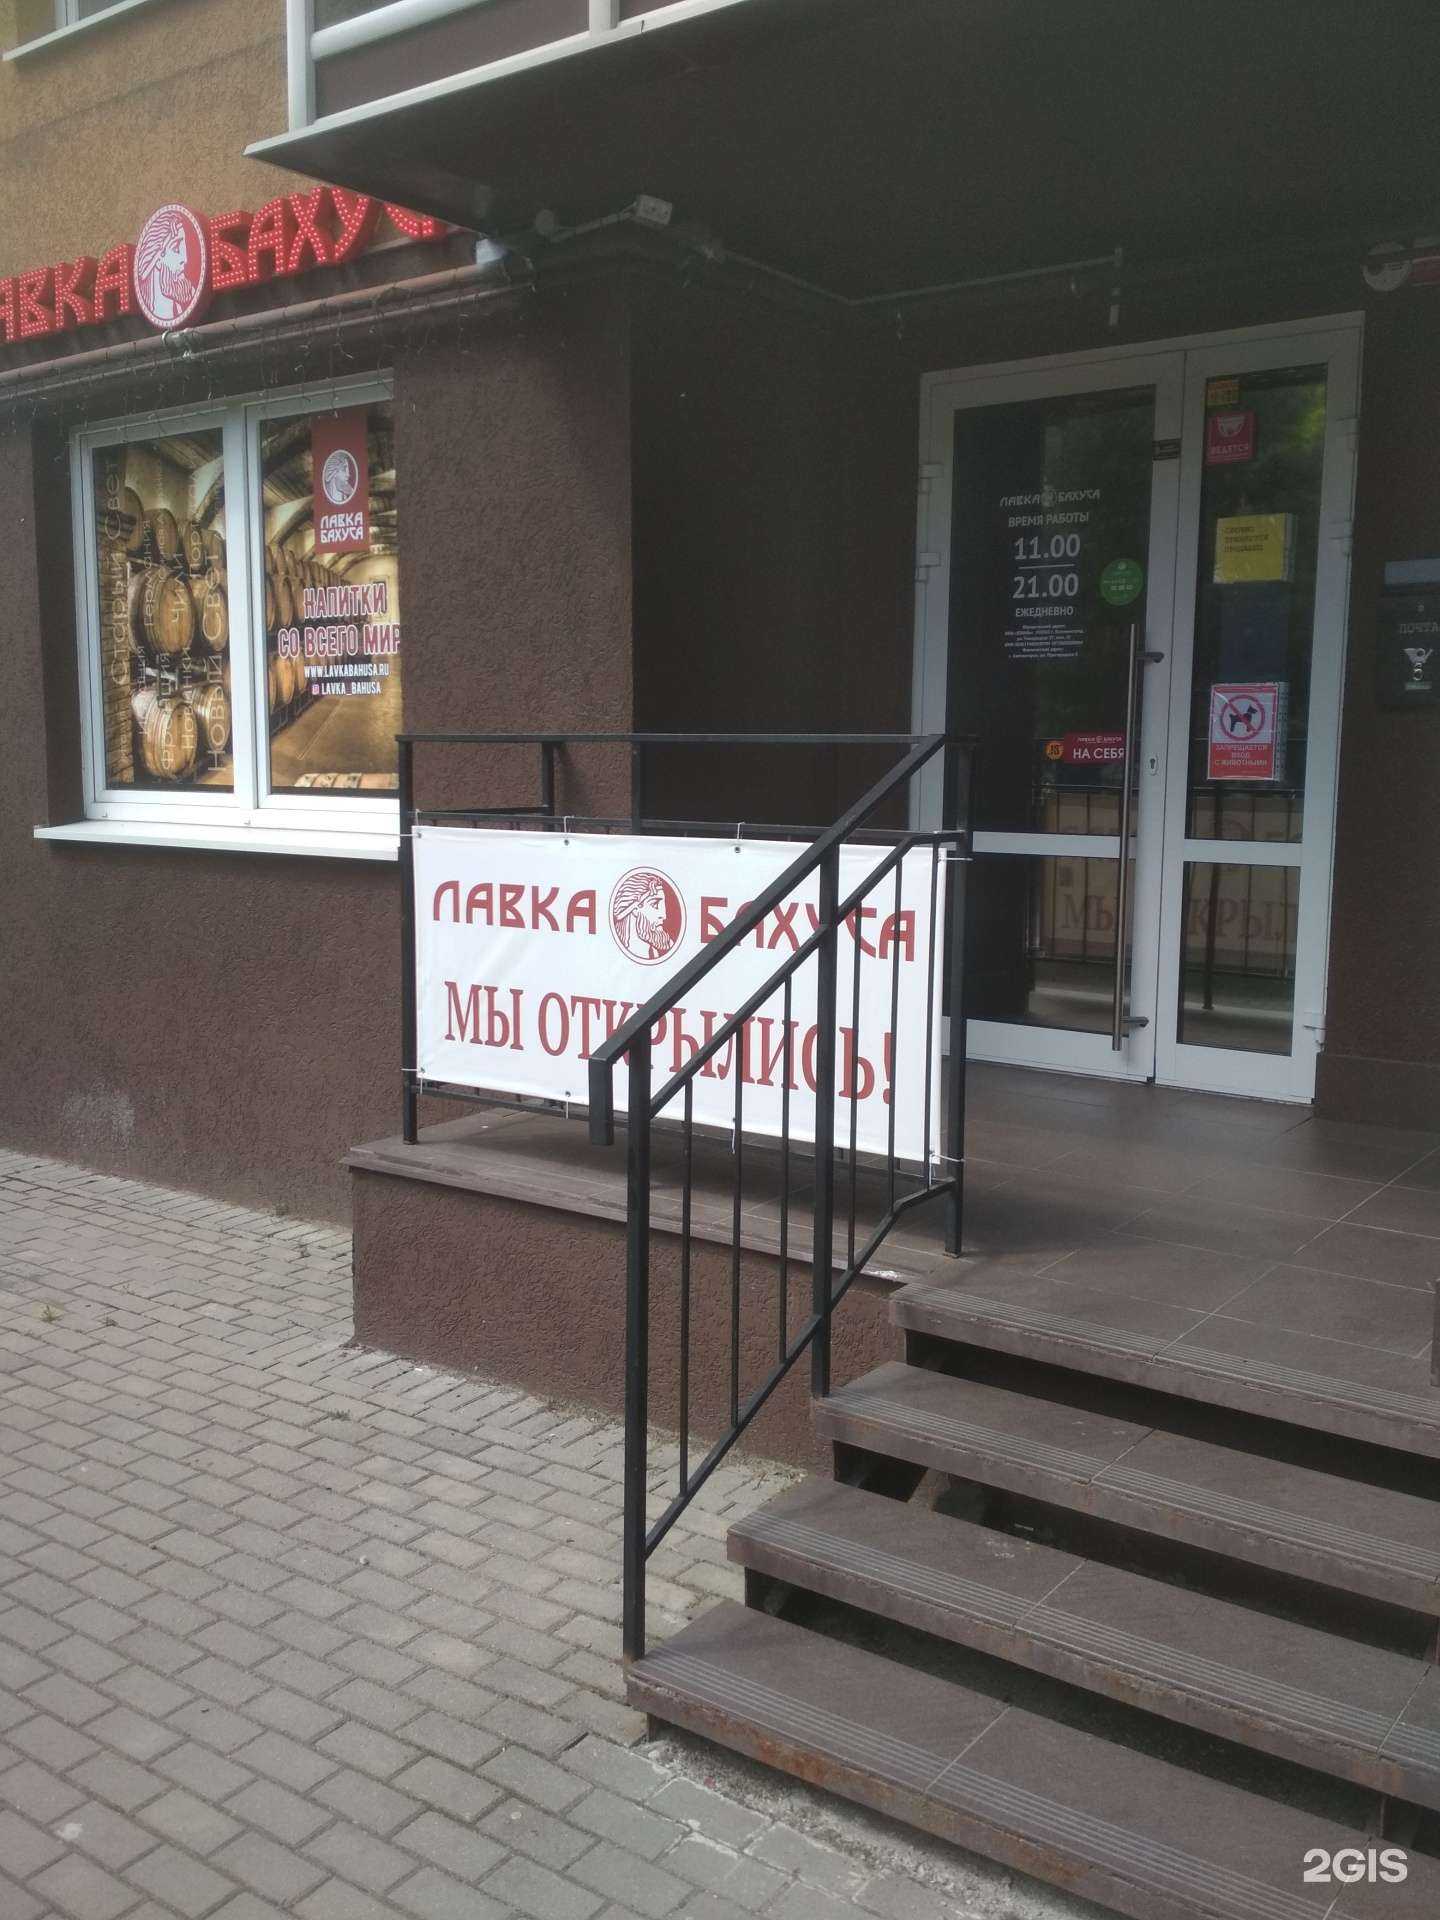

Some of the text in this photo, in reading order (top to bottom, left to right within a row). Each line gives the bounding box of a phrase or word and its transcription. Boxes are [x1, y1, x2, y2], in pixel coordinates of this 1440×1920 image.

[1000, 489, 1101, 507] ЛАВКА БАХУСА
[320, 511, 364, 529] ЛАВКА
[1008, 511, 1089, 527] ВРЕМЯ РАБОТЫ
[320, 527, 364, 543] БАХУСА
[1014, 533, 1081, 561] 11.00
[171, 553, 185, 623] Чили
[203, 551, 222, 641] Свет
[1012, 573, 1079, 599] 21.00
[303, 583, 388, 619] НАПИТКИ
[1015, 606, 1074, 618] ЕЖЕДНЕВНО
[278, 628, 300, 659] СО
[304, 625, 359, 658] ВСЕГО
[304, 663, 390, 678] WWW.LAVKABAHUSA.RU
[182, 647, 194, 749] Новинки
[321, 681, 381, 696] LAVKA_BAHUSA
[203, 654, 226, 771] Новый
[1073, 747, 1124, 759] НА СЕБЯ
[433, 880, 597, 935] ЛАВКА
[444, 981, 523, 1051] МЫ
